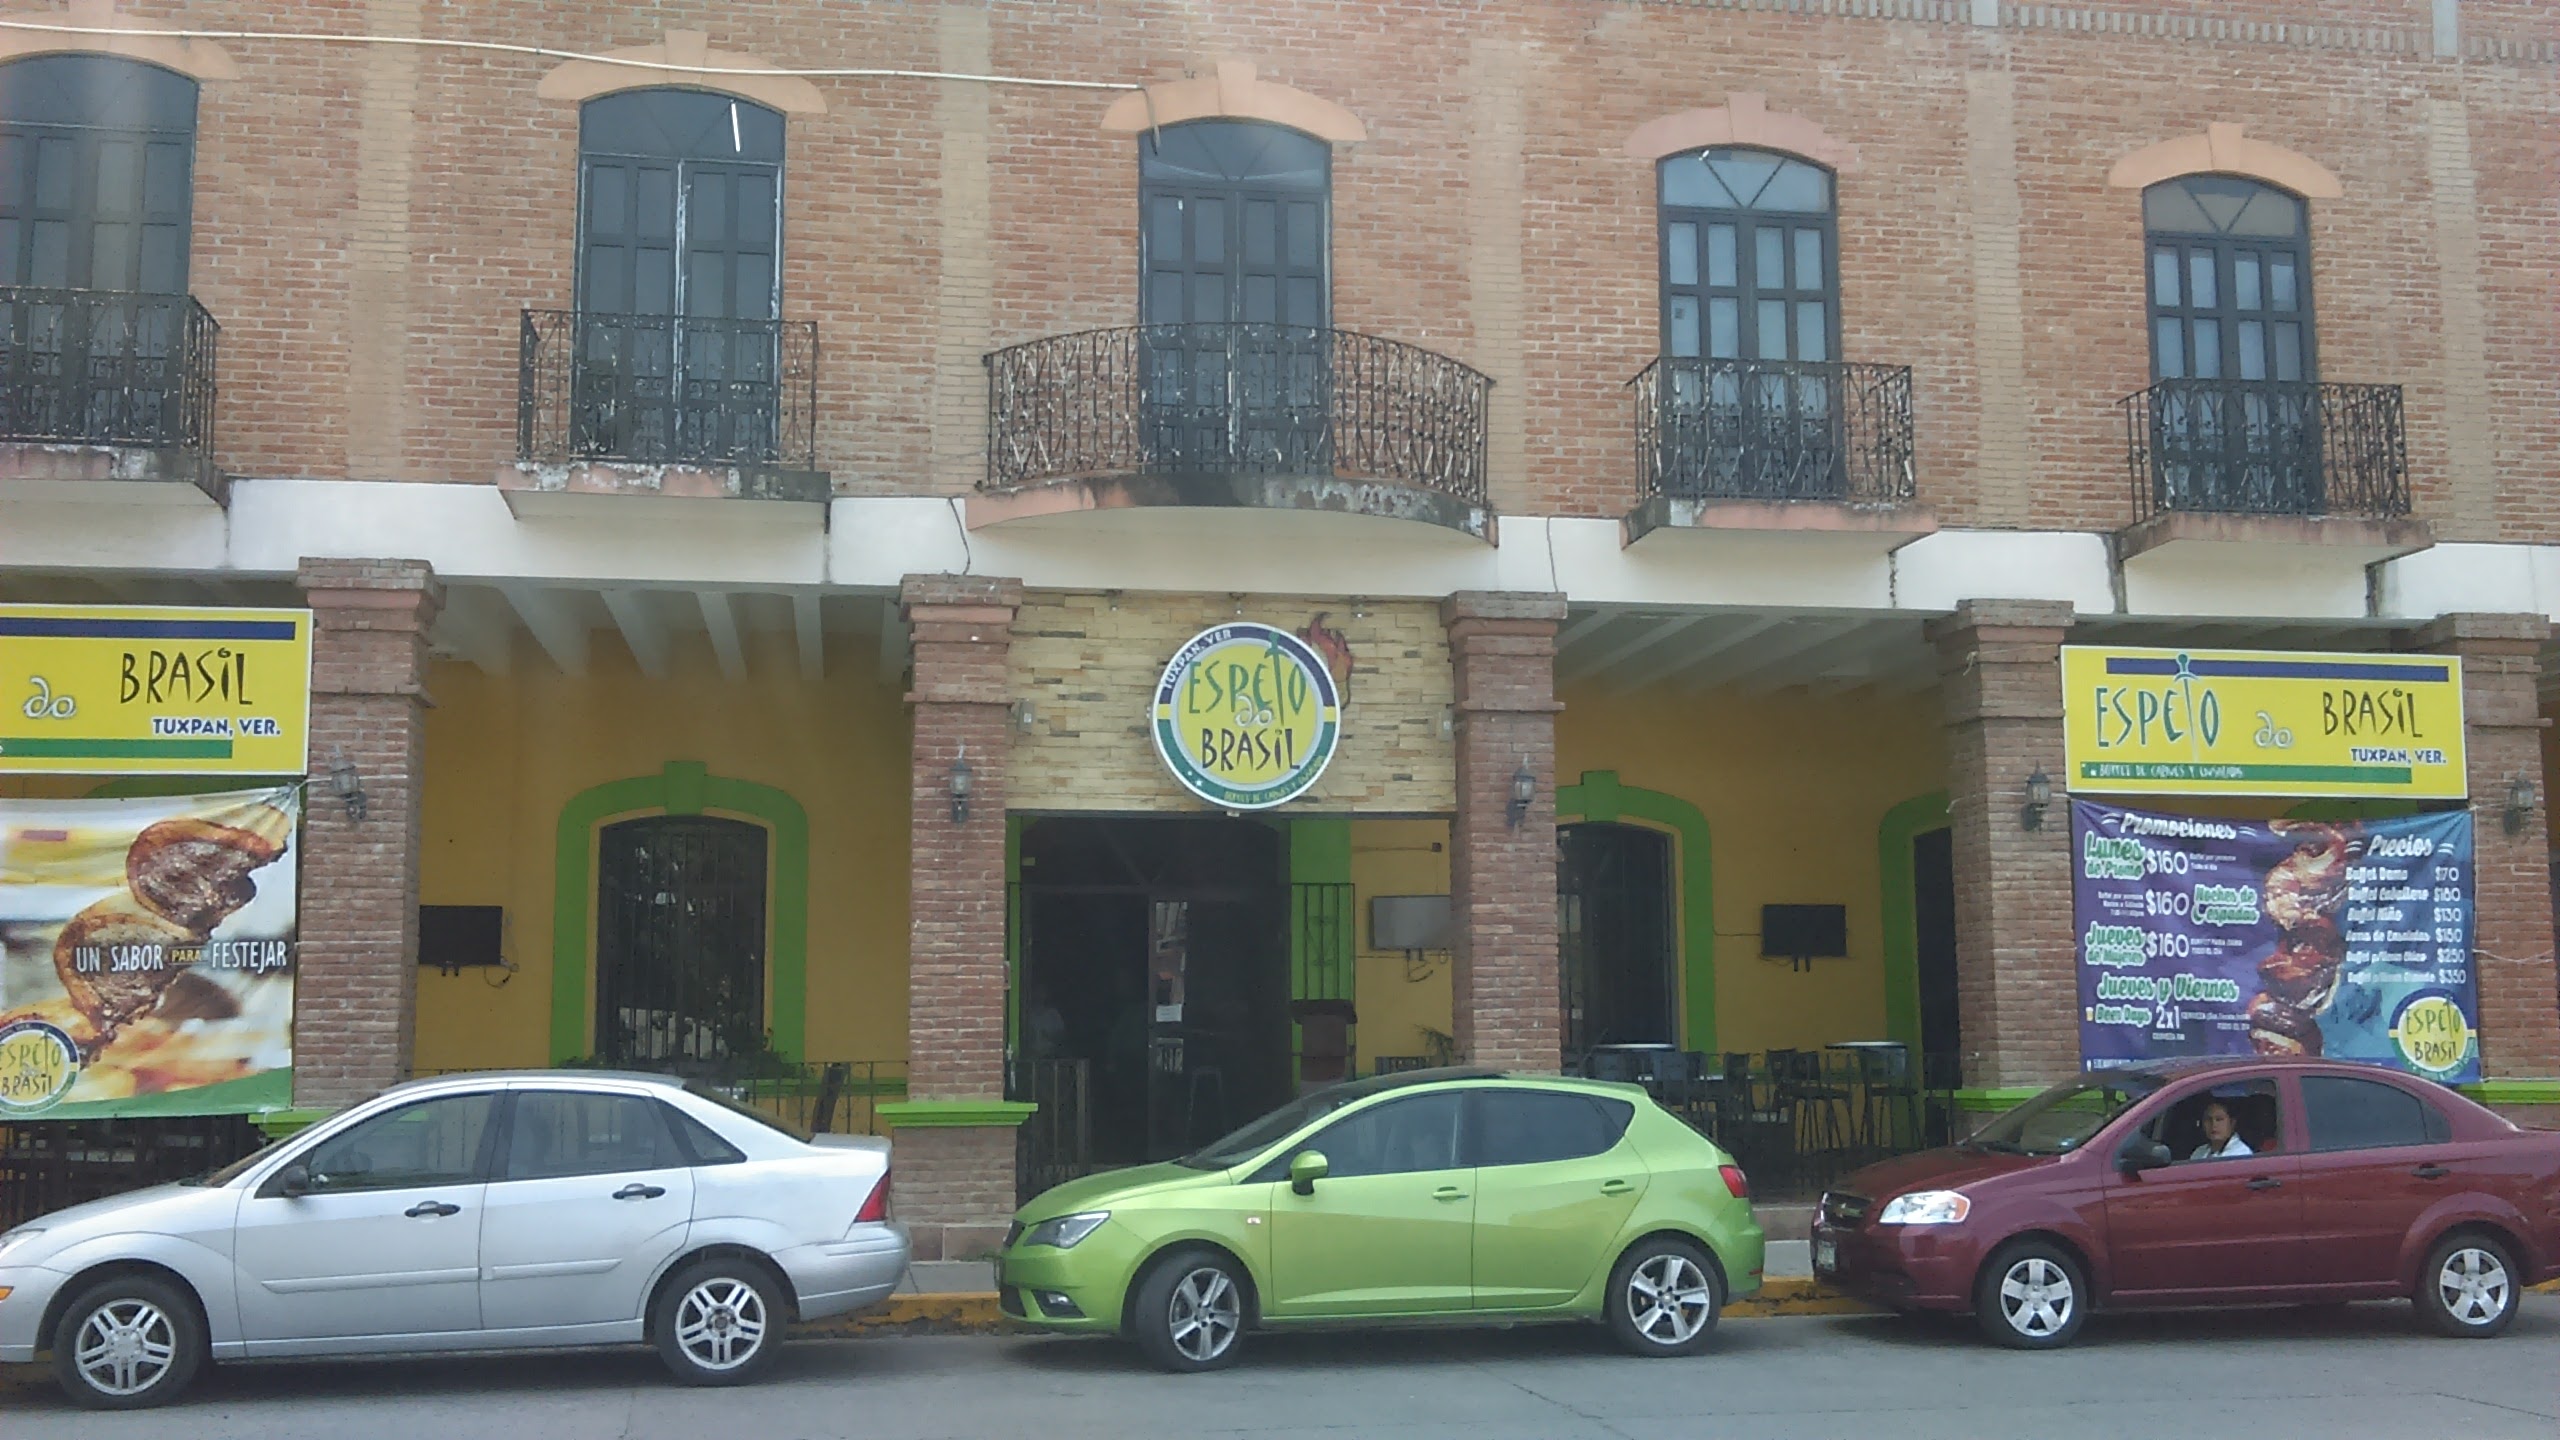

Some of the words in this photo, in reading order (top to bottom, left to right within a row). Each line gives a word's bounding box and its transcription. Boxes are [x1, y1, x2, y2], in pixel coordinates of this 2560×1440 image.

[1188, 642, 1307, 723] ESPETO
[2095, 663, 2220, 757] ESPETO
[153, 718, 233, 737] TUXPAN,
[239, 718, 281, 735] VER.
[2350, 748, 2412, 767] TUXPAN,
[2415, 749, 2447, 765] VER.
[2120, 813, 2237, 840] Promociones
[2085, 831, 2146, 862] Lunes
[2367, 834, 2433, 857] Precios
[2145, 848, 2189, 875] $160
[2145, 889, 2190, 916] $160
[2239, 884, 2258, 906] de
[2085, 921, 2146, 947] Jueves
[2145, 931, 2190, 958] $160
[75, 946, 100, 973] UN
[110, 944, 164, 972] SABOR
[171, 949, 201, 963] PARA
[211, 941, 288, 974] FESTEJAR
[2097, 972, 2156, 1001] Jueves
[2156, 978, 2172, 1005] y
[2173, 974, 2240, 1002] Viernes
[2155, 1005, 2180, 1029] 2x1
